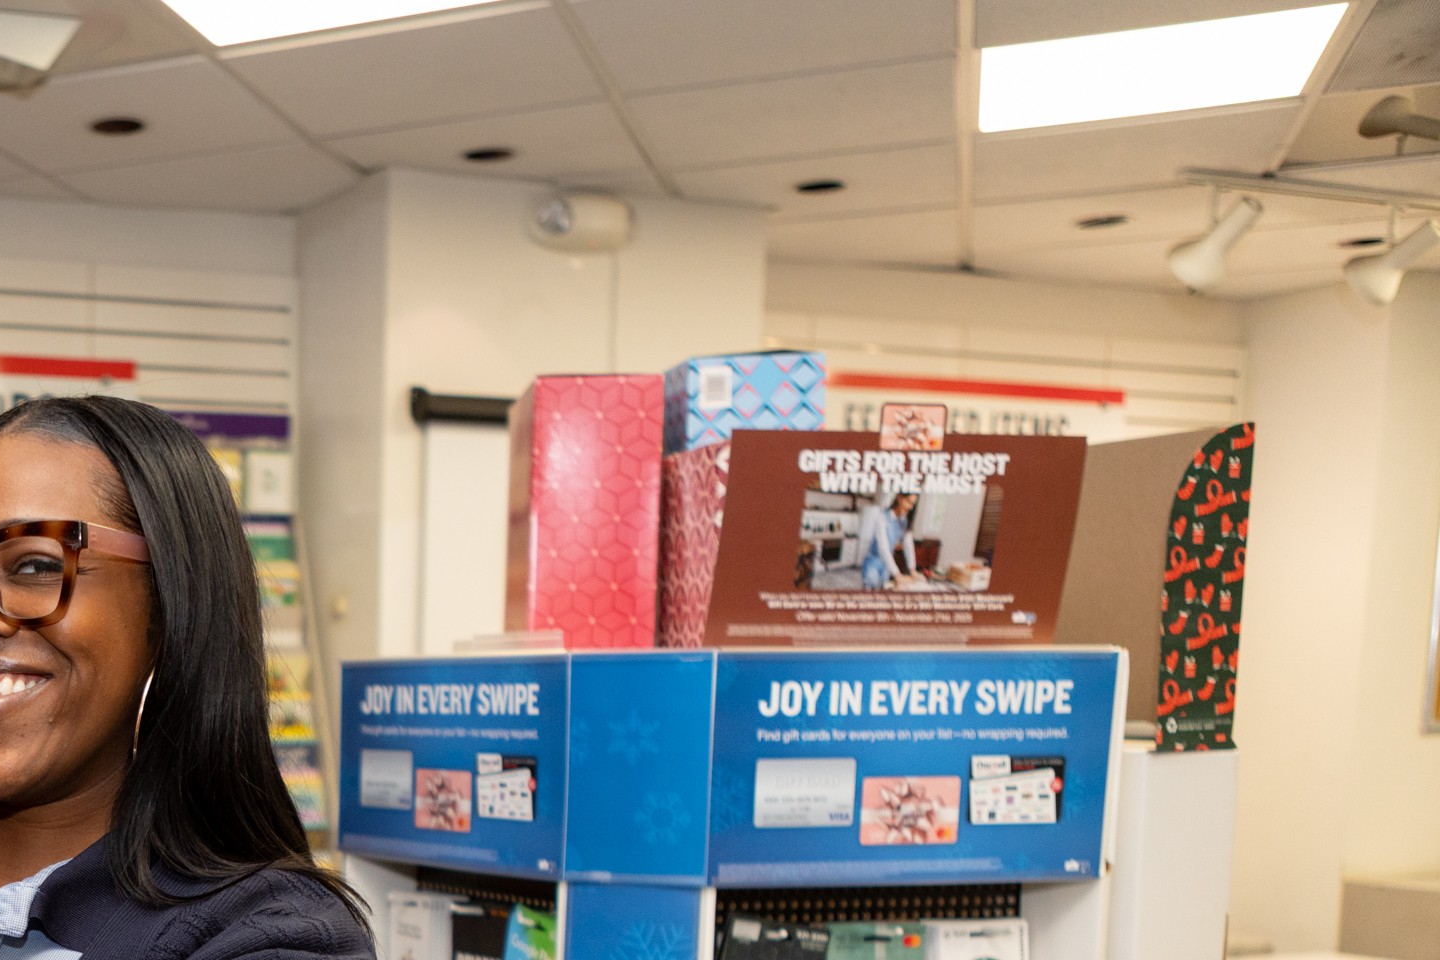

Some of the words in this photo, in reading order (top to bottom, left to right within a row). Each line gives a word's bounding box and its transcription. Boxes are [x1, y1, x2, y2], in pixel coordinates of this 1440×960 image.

[798, 449, 861, 474] GIFTS
[863, 451, 905, 474] FOR
[909, 452, 950, 474] THE
[952, 452, 1010, 476] HOST
[819, 472, 878, 494] WITH
[881, 473, 923, 494] THE
[924, 475, 987, 495] MOST
[362, 684, 394, 715] JOY
[396, 684, 414, 714] IN
[418, 684, 475, 715] EVERY
[477, 683, 540, 716] SWIPE
[758, 680, 824, 717] JOY
[829, 680, 863, 717] IN
[869, 680, 971, 717] EVERY
[974, 678, 1075, 716] SWIPE
[757, 728, 781, 742] Find
[782, 728, 800, 744] gift
[801, 728, 831, 742] cards
[832, 728, 847, 742] for
[848, 730, 896, 744] everyone
[897, 730, 911, 741] on
[912, 730, 936, 743] your
[977, 728, 1025, 743] wrapping
